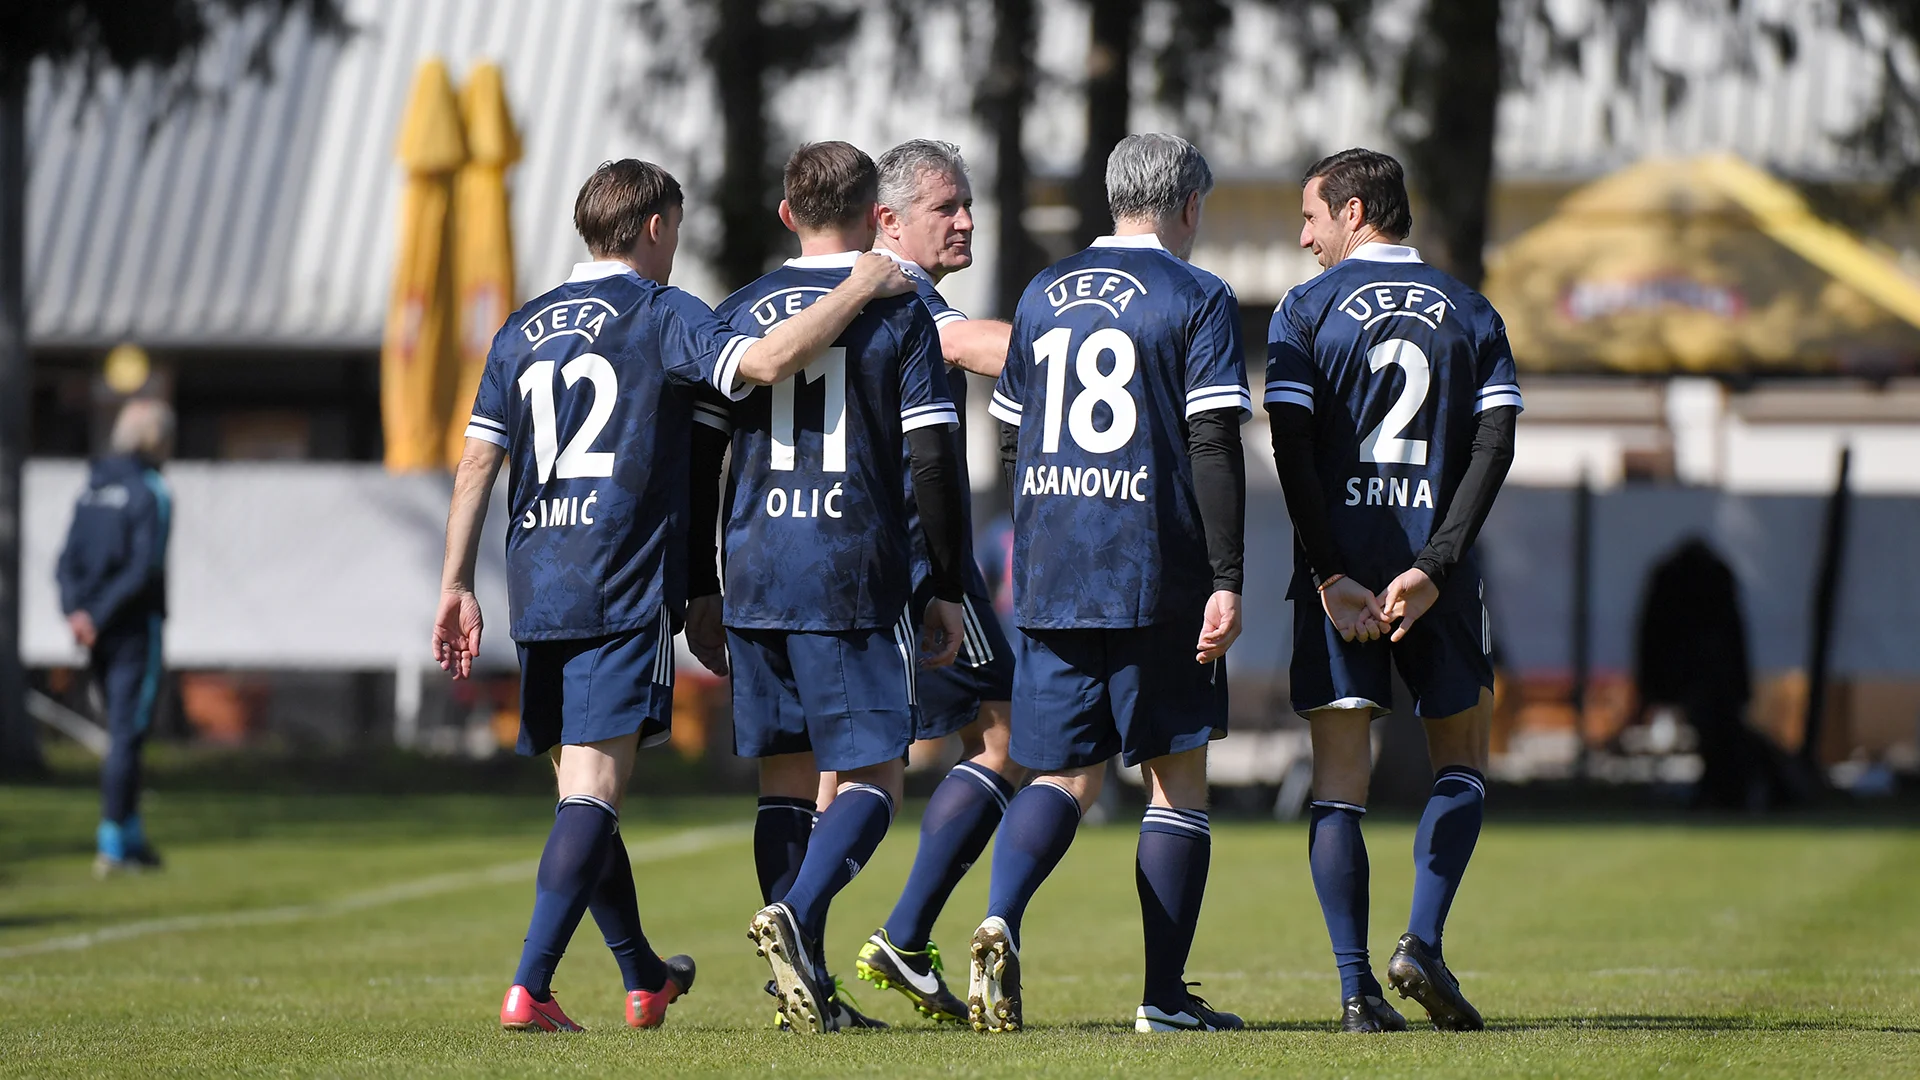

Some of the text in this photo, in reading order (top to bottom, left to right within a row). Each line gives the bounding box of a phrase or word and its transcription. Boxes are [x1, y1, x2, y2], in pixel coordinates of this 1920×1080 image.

[753, 292, 865, 326] UE
[1047, 274, 1136, 313] UEFA
[1344, 288, 1447, 324] UEFA
[524, 305, 607, 343] UEFA
[770, 346, 847, 472] 11
[1032, 327, 1137, 455] 18
[1359, 338, 1430, 466] 2
[517, 353, 619, 485] 12
[765, 481, 844, 519] OLIĆ
[1022, 465, 1149, 503] ASANOVIĆ
[1345, 477, 1434, 509] SRNA
